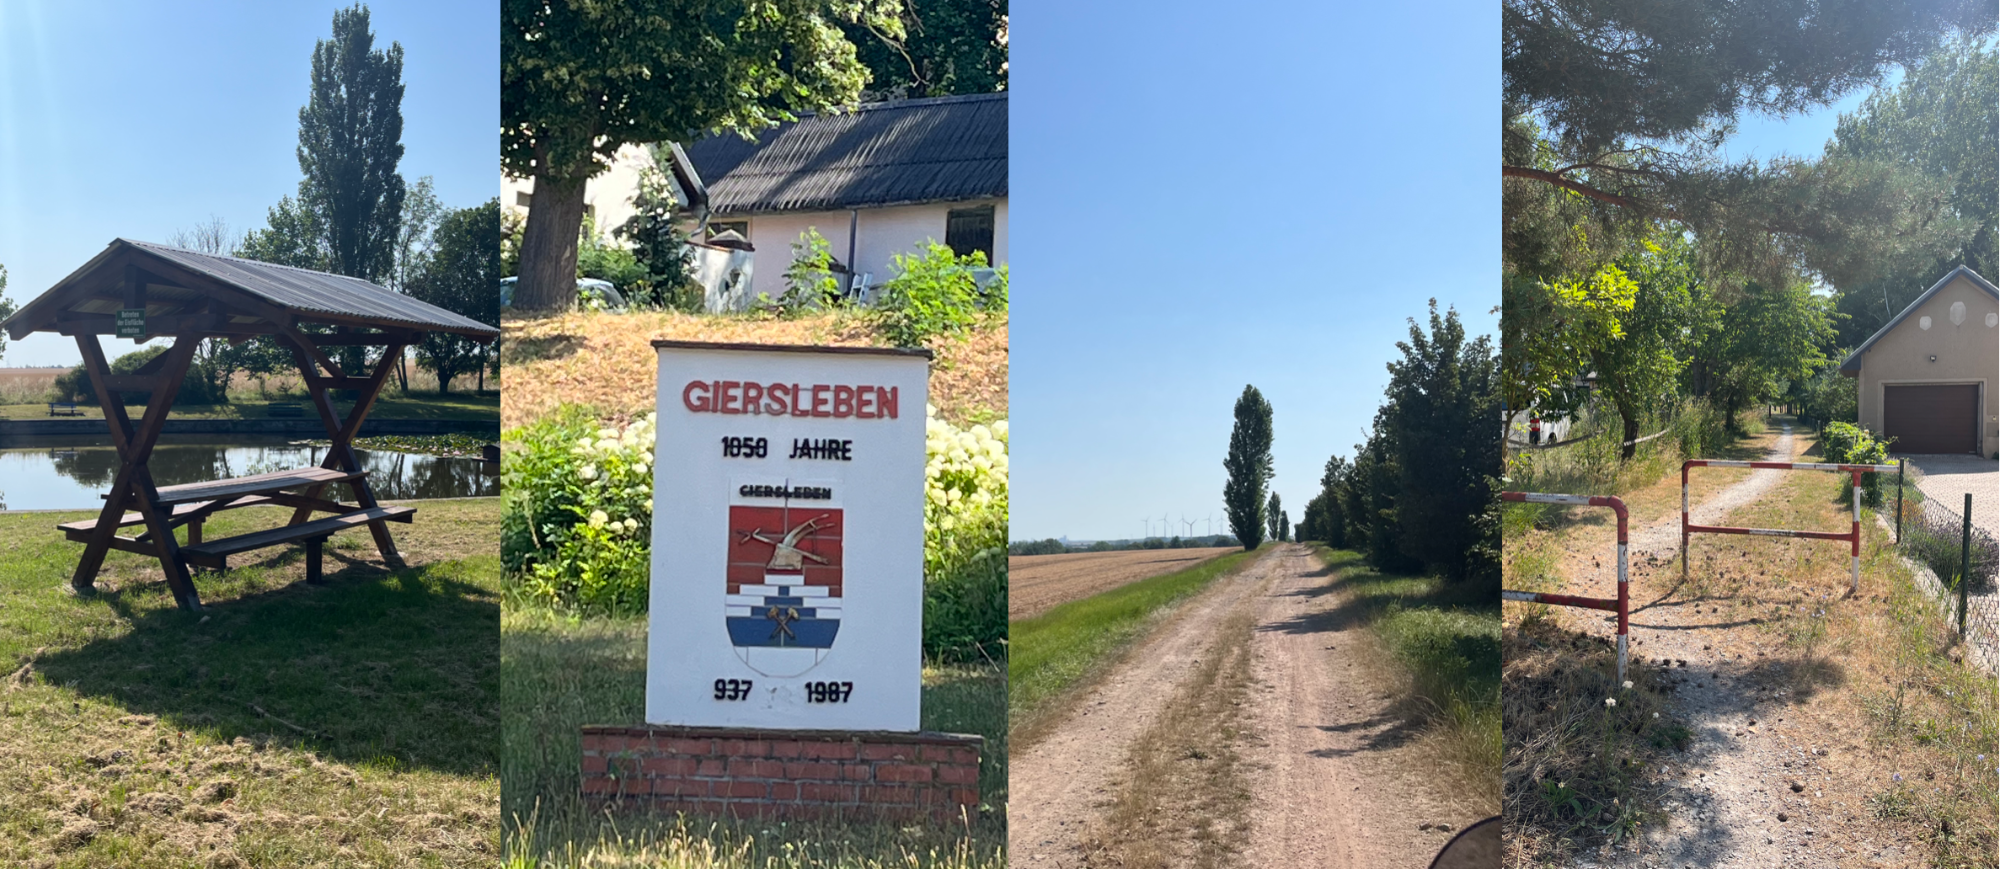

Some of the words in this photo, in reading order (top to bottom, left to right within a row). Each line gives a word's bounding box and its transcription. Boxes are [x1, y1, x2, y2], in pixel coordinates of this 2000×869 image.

[682, 380, 898, 419] GIERSLEBEN
[721, 436, 768, 458] 1050
[789, 438, 853, 461] JAHRE
[739, 484, 832, 500] GIERSLEBEN
[714, 678, 752, 702] 937
[804, 681, 854, 704] 1987
